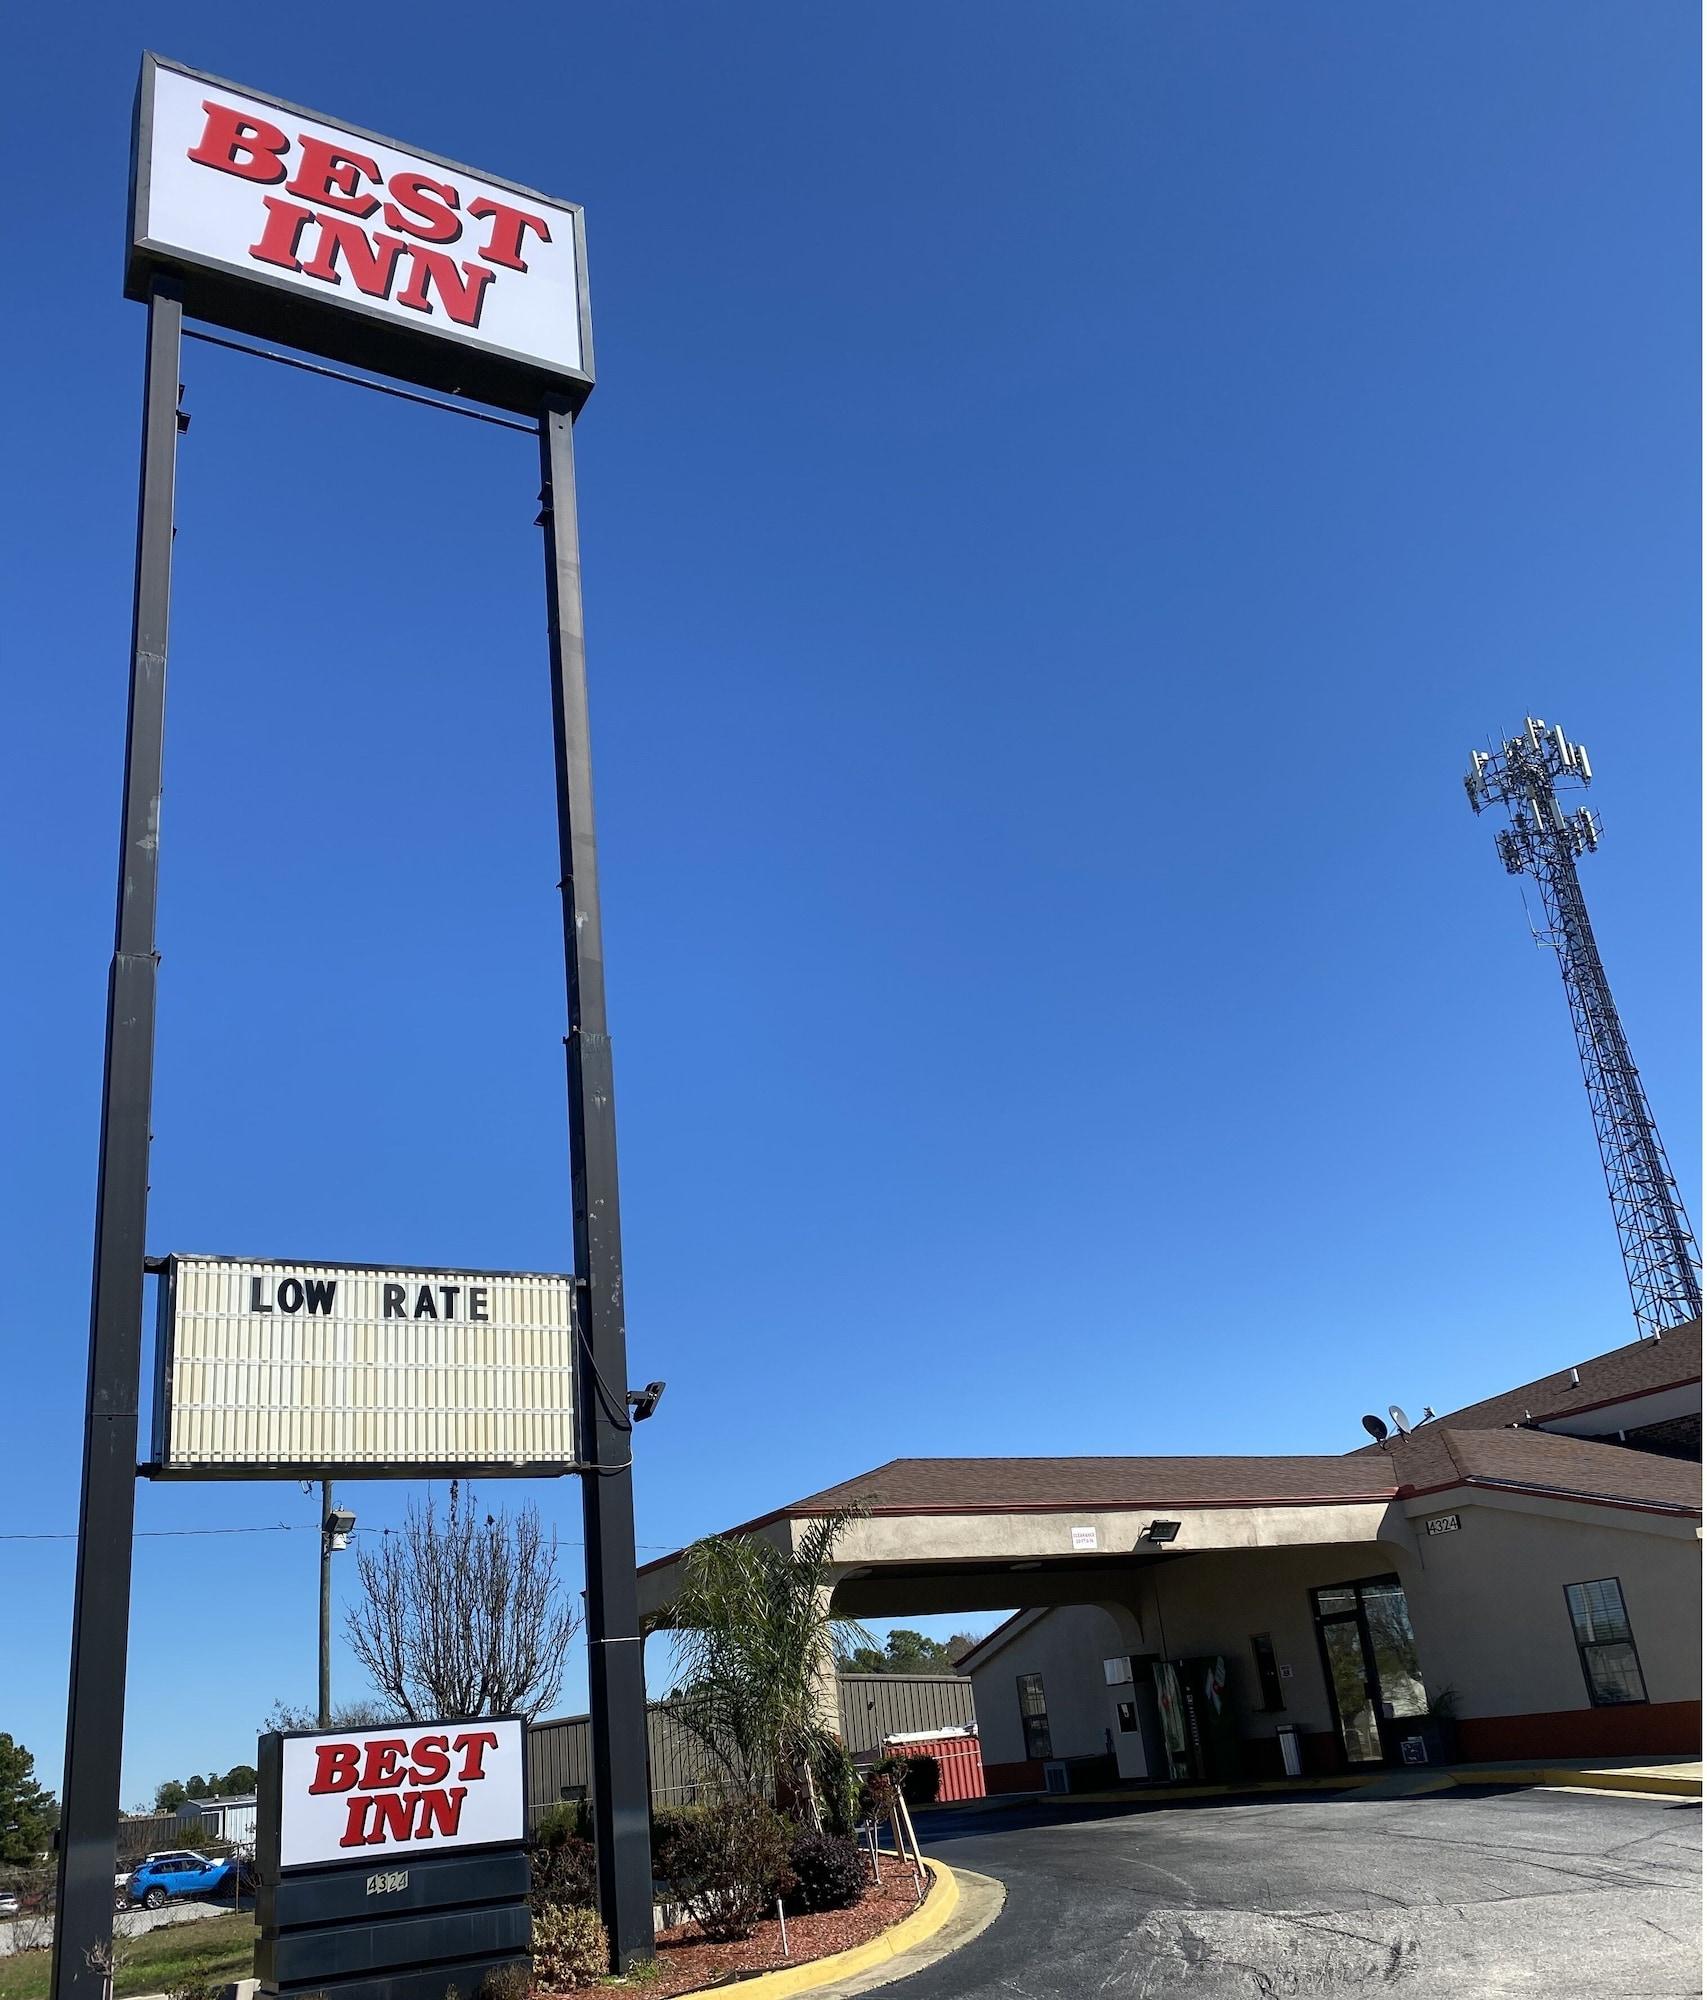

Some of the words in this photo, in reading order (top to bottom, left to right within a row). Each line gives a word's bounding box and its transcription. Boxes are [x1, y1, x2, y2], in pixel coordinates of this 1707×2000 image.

[187, 99, 552, 273] BEST
[248, 195, 496, 329] INN
[251, 1277, 337, 1315] LOW
[383, 1283, 489, 1321] RATE
[1429, 1517, 1457, 1533] 4324
[308, 1732, 498, 1795] BEST
[339, 1787, 468, 1848] INN
[367, 1872, 407, 1891] 4324
